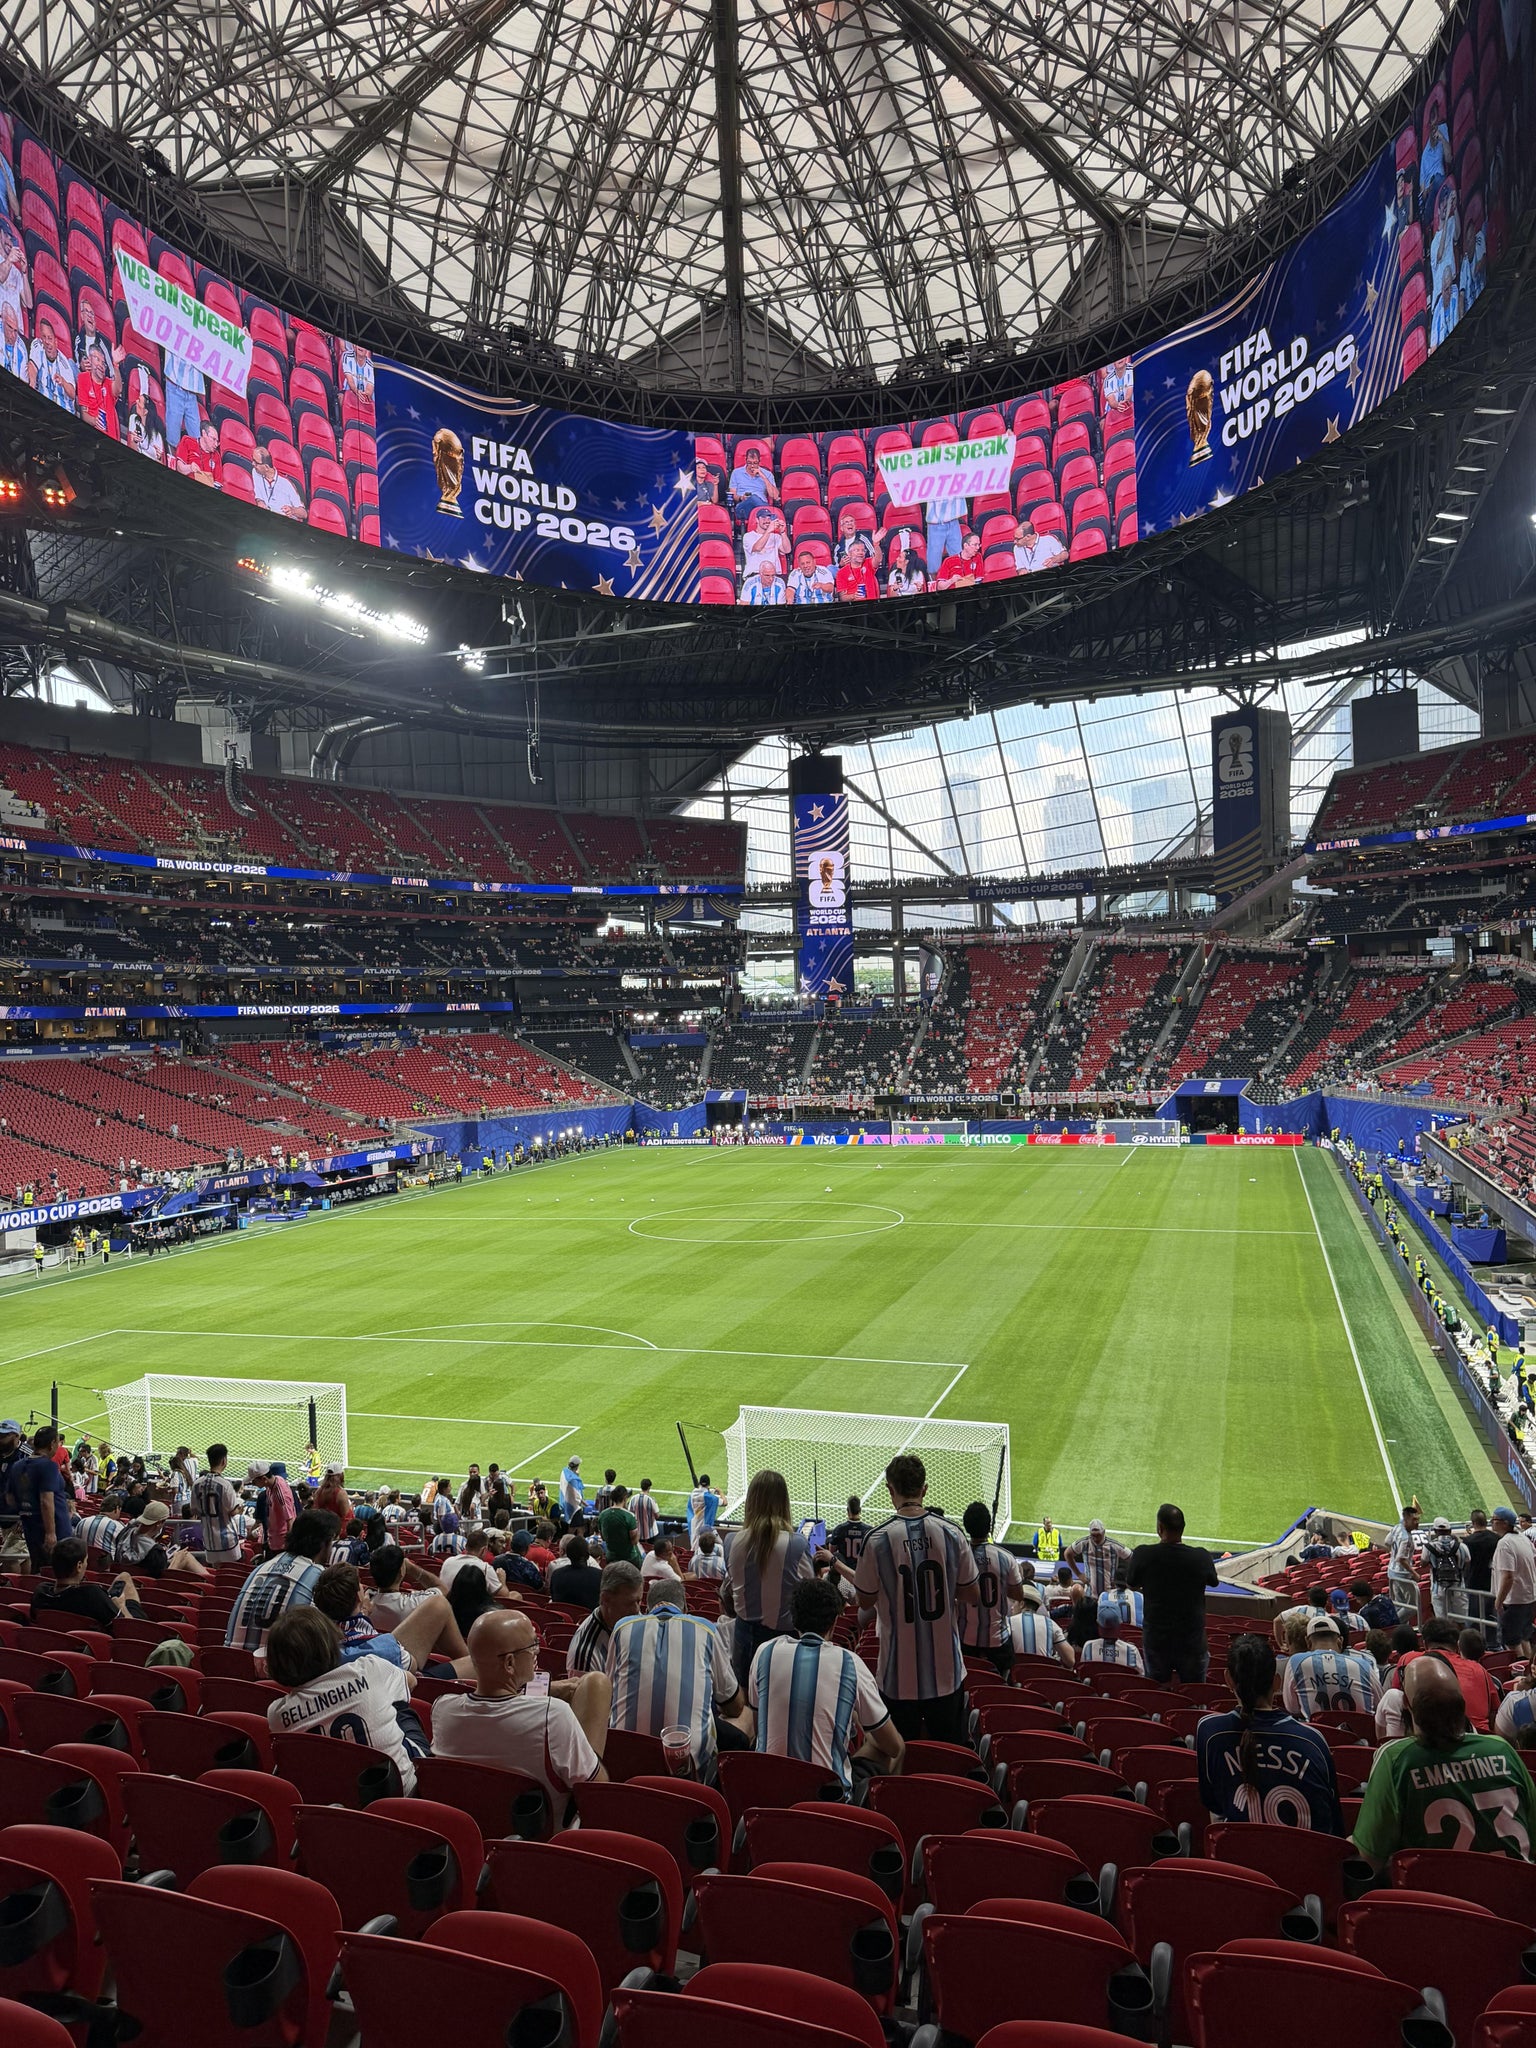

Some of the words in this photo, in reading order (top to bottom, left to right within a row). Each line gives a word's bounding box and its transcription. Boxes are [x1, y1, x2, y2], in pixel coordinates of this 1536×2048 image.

[117, 251, 150, 289] we
[154, 276, 179, 309] all
[181, 290, 246, 355] speak
[1219, 327, 1272, 383] FIFA
[1219, 336, 1308, 414] WORLD
[1221, 398, 1270, 447] CUP
[1274, 334, 1355, 418] 2026
[471, 436, 534, 475] FIFA
[879, 453, 912, 472] we
[917, 445, 941, 466] all
[943, 436, 1009, 466] speak
[472, 466, 577, 512] WORLD
[474, 498, 531, 531] CUP
[536, 514, 637, 551] 2026
[1228, 769, 1244, 778] FIFA
[1219, 782, 1241, 791] WORLD
[1219, 787, 1254, 799] 2026
[1315, 838, 1360, 852] ATLANTA
[156, 858, 175, 869] FIFA
[175, 860, 212, 871] WORLD
[213, 863, 232, 873] CUP
[233, 864, 267, 875] 2026
[391, 877, 429, 887] ATLANTA
[975, 889, 995, 897] FIFA
[995, 886, 1029, 895] WORLD
[1030, 885, 1049, 893] CUP
[1050, 882, 1084, 892] 2026
[809, 915, 847, 924] 2026
[806, 927, 851, 937] ATLANTA
[112, 963, 153, 971] ATLANTA
[84, 1007, 127, 1017] ATLANTA
[237, 1006, 258, 1015] FIFA
[259, 1006, 291, 1015] WORLD
[292, 1005, 309, 1014] CUP
[310, 1005, 340, 1014] 2026
[446, 1003, 480, 1011] ATLANTA
[909, 1095, 925, 1103] FIFA
[926, 1095, 953, 1103] WORLD
[970, 1094, 999, 1102] 2026
[811, 1135, 837, 1145] VISA
[959, 1134, 1011, 1144] aramco
[1233, 1135, 1275, 1144] Lenovo
[214, 1175, 249, 1190] ATLANTA
[0, 1209, 47, 1230] WORLD
[49, 1203, 77, 1220] CUP
[78, 1195, 122, 1216] 2026
[903, 1536, 933, 1553] MESSI
[898, 1559, 945, 1624] 10
[241, 1576, 291, 1628] 10
[1309, 1672, 1354, 1690] MESSI
[281, 1675, 370, 1729] BELLINGHAM
[1409, 1753, 1512, 1790] E.MARTÍNEZ
[1233, 1782, 1312, 1831] 10
[1423, 1786, 1534, 1864] 23
